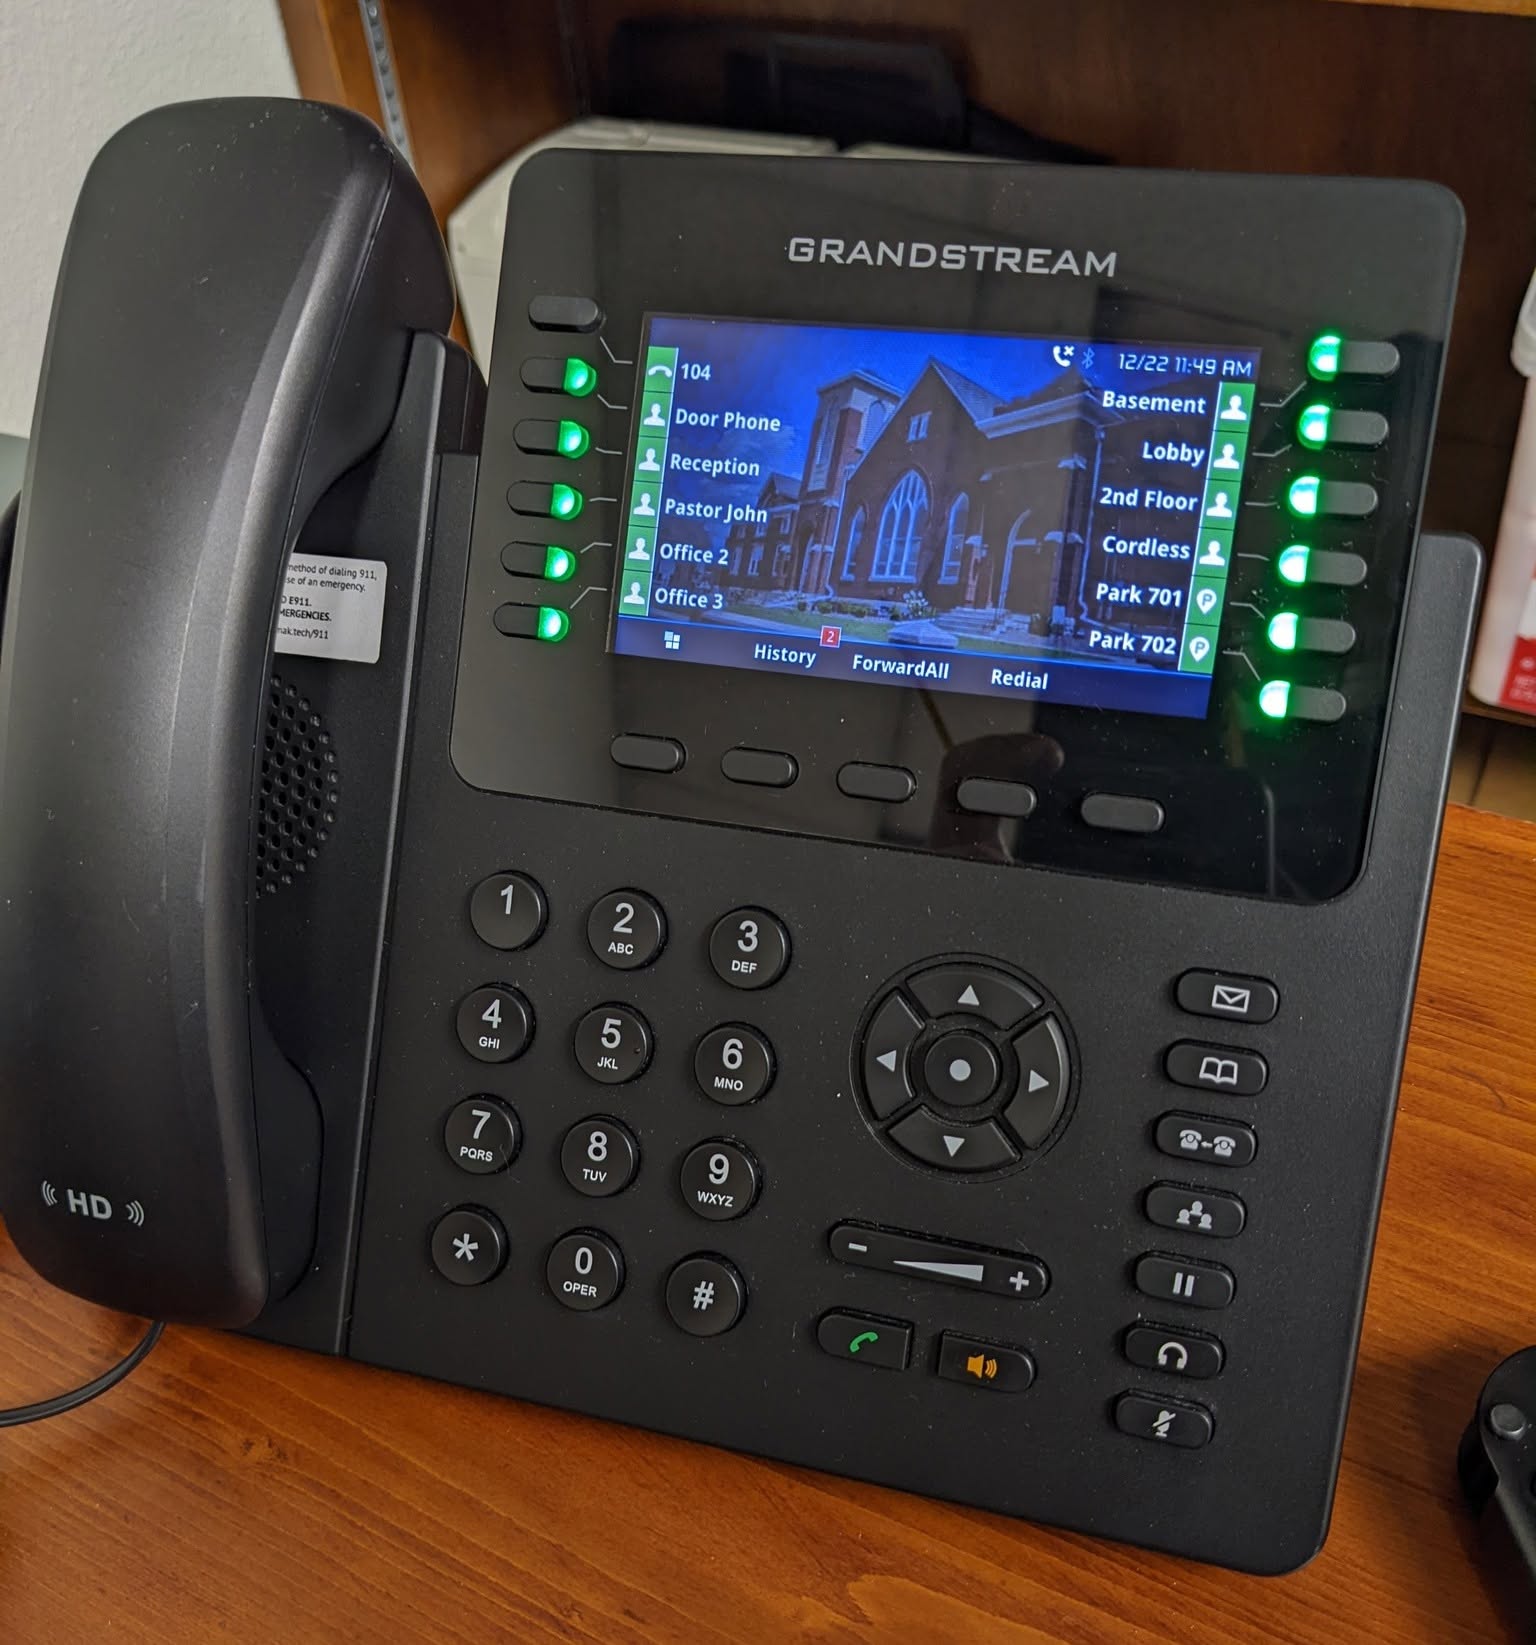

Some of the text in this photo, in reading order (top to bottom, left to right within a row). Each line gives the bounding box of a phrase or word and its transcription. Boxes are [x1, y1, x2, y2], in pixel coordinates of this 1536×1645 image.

[788, 237, 1117, 277] GRANDSTREAM
[681, 363, 711, 381] 104
[1119, 354, 1252, 377] 12/22 11:49 AM
[1102, 390, 1207, 414] Basement
[675, 408, 781, 432] Door Phone
[670, 453, 760, 478] Reception
[1142, 442, 1206, 467] Lobby
[665, 498, 768, 523] Pastor John
[1100, 487, 1199, 511] 2nd Floor
[660, 543, 729, 565] Office 2
[1103, 536, 1191, 560] Cordless
[297, 577, 306, 586] of
[307, 579, 318, 587] an
[318, 566, 327, 575] of
[328, 566, 358, 579] dialing
[655, 587, 723, 610] Office 3
[1096, 583, 1182, 608] Park 701
[826, 630, 835, 643] 2
[1089, 630, 1176, 655] Park 702
[754, 643, 817, 669] History
[852, 654, 950, 680] ForwardAll
[991, 668, 1049, 690] Redial
[501, 885, 513, 914] 1
[613, 903, 634, 933] 2
[608, 942, 633, 955] ABC
[738, 921, 758, 952] 3
[732, 960, 757, 973] DEF
[482, 999, 501, 1028] 4
[479, 1037, 500, 1049] GHI
[601, 1018, 621, 1048] 5
[597, 1057, 618, 1070] JKL
[723, 1039, 743, 1069] 6
[714, 1077, 743, 1091] MNO
[472, 1110, 490, 1139] 7
[460, 1146, 492, 1161] PQRS
[588, 1132, 607, 1161] 8
[583, 1169, 607, 1182] TUV
[709, 1154, 729, 1184] 9
[67, 1189, 112, 1219] HD
[698, 1191, 733, 1207] WXYZ
[575, 1247, 592, 1274] 0
[563, 1281, 596, 1297] OPER
